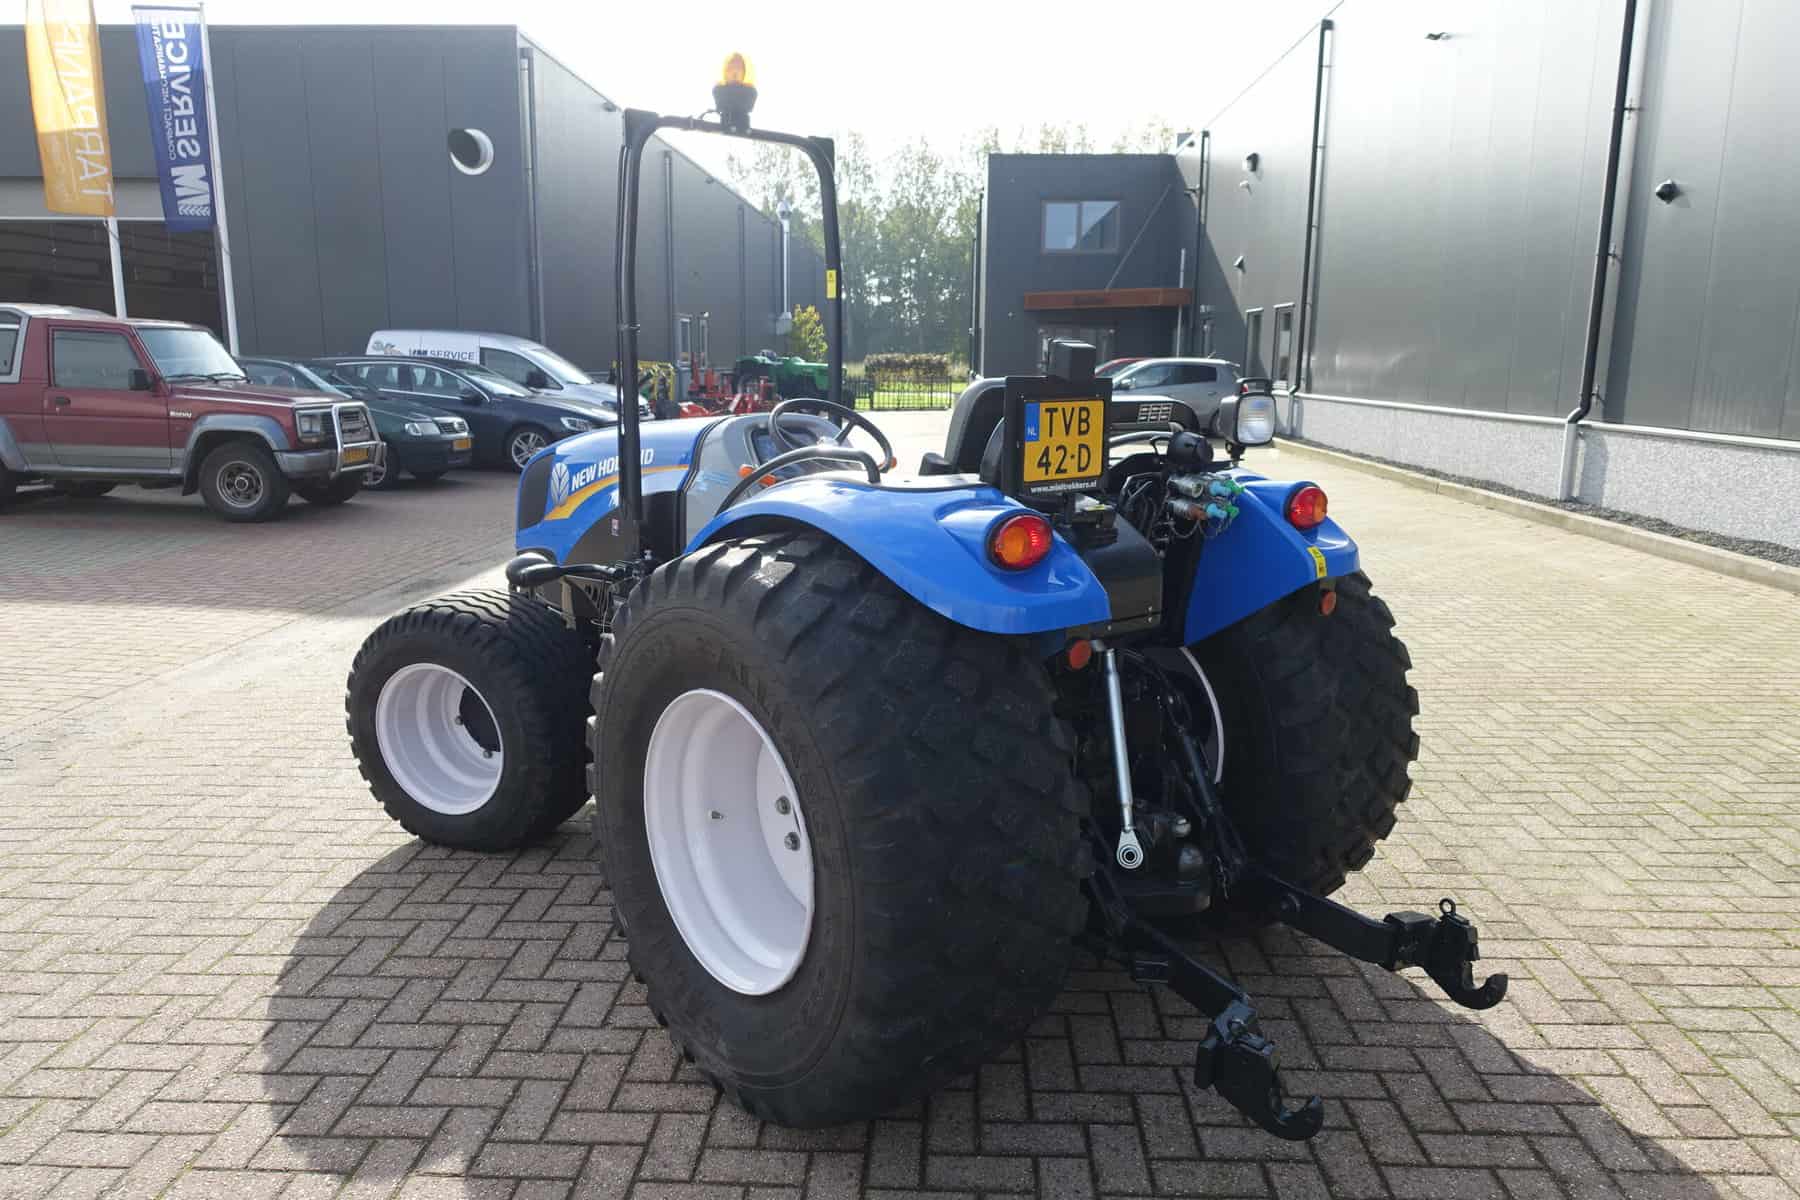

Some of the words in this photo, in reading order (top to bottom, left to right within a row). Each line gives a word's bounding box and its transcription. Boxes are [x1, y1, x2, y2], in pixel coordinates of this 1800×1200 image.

[430, 350, 475, 361] SERVICE
[1027, 426, 1038, 437] NL
[1044, 406, 1091, 438] TVB
[571, 463, 597, 492] NEW
[597, 447, 655, 478] HOLD
